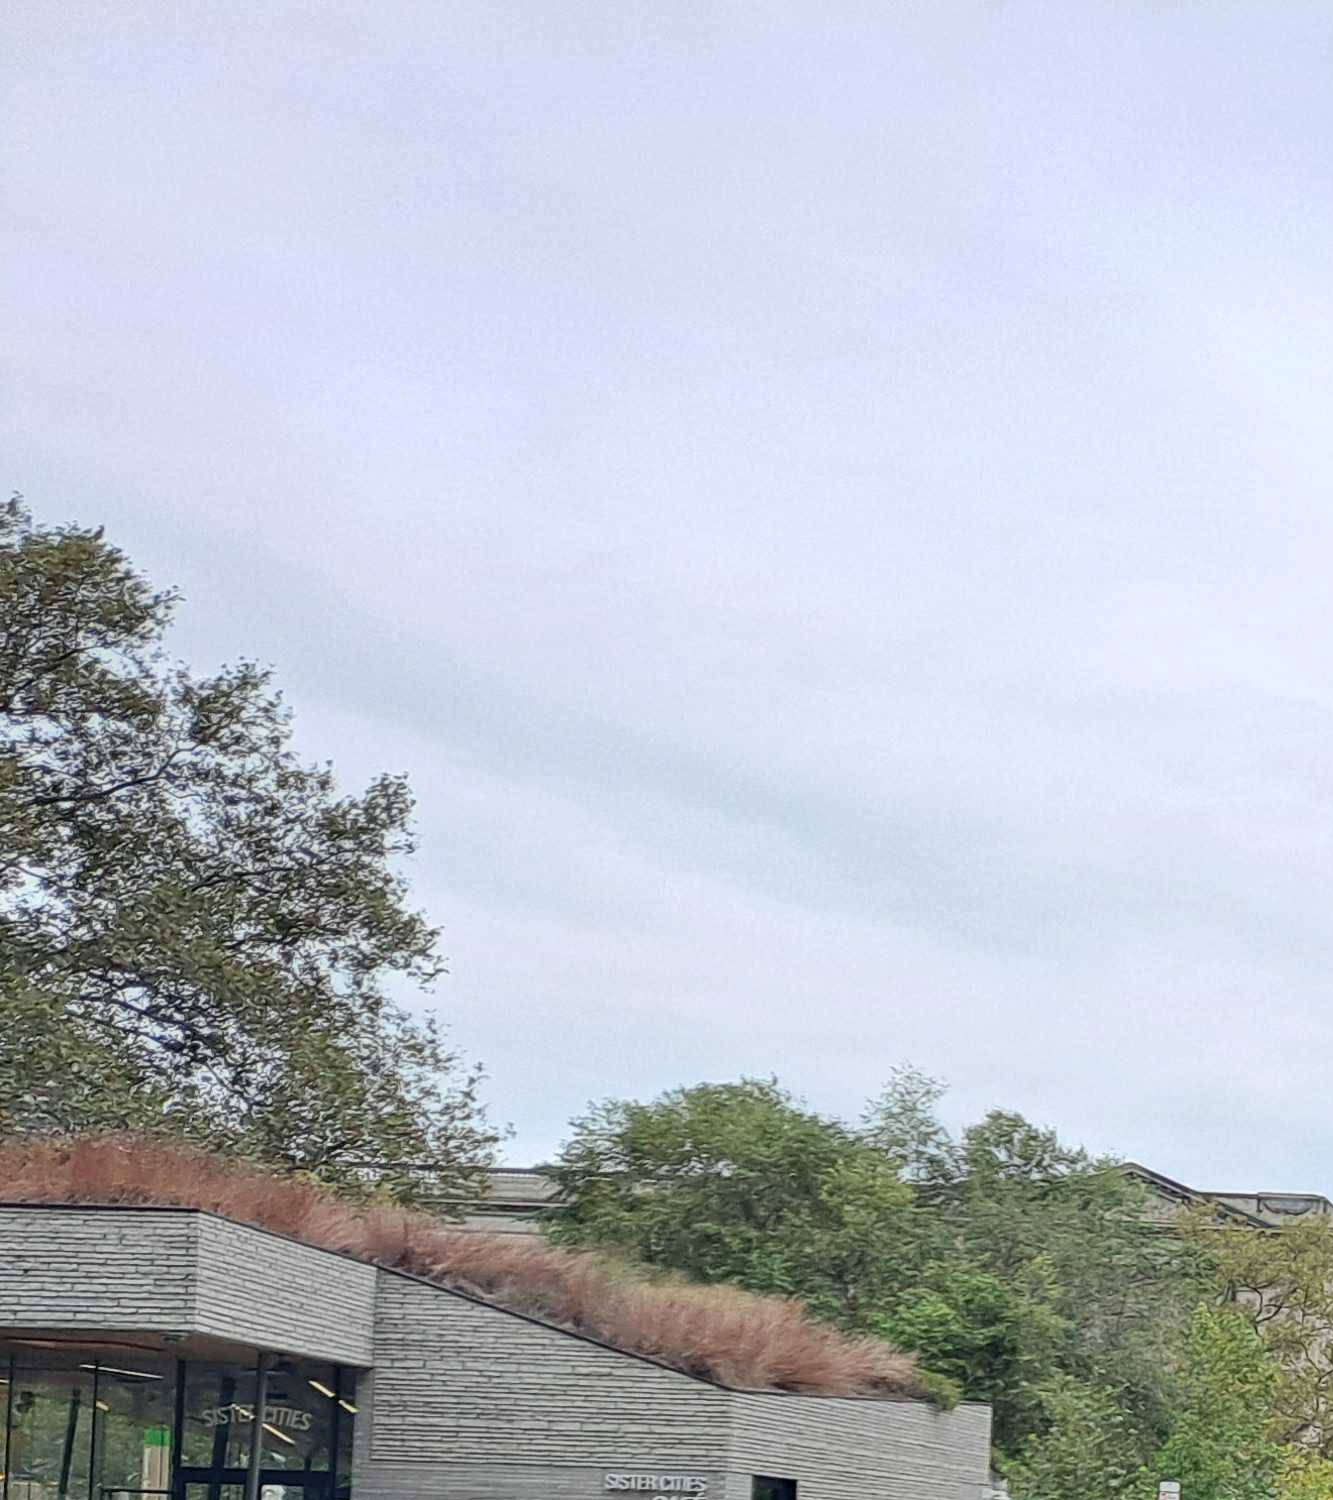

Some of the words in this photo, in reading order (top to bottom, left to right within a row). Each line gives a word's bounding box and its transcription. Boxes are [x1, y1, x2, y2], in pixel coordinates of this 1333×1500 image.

[201, 1404, 256, 1427] SISTE
[605, 1473, 658, 1490] SISTER
[659, 1475, 707, 1491] CITIES
